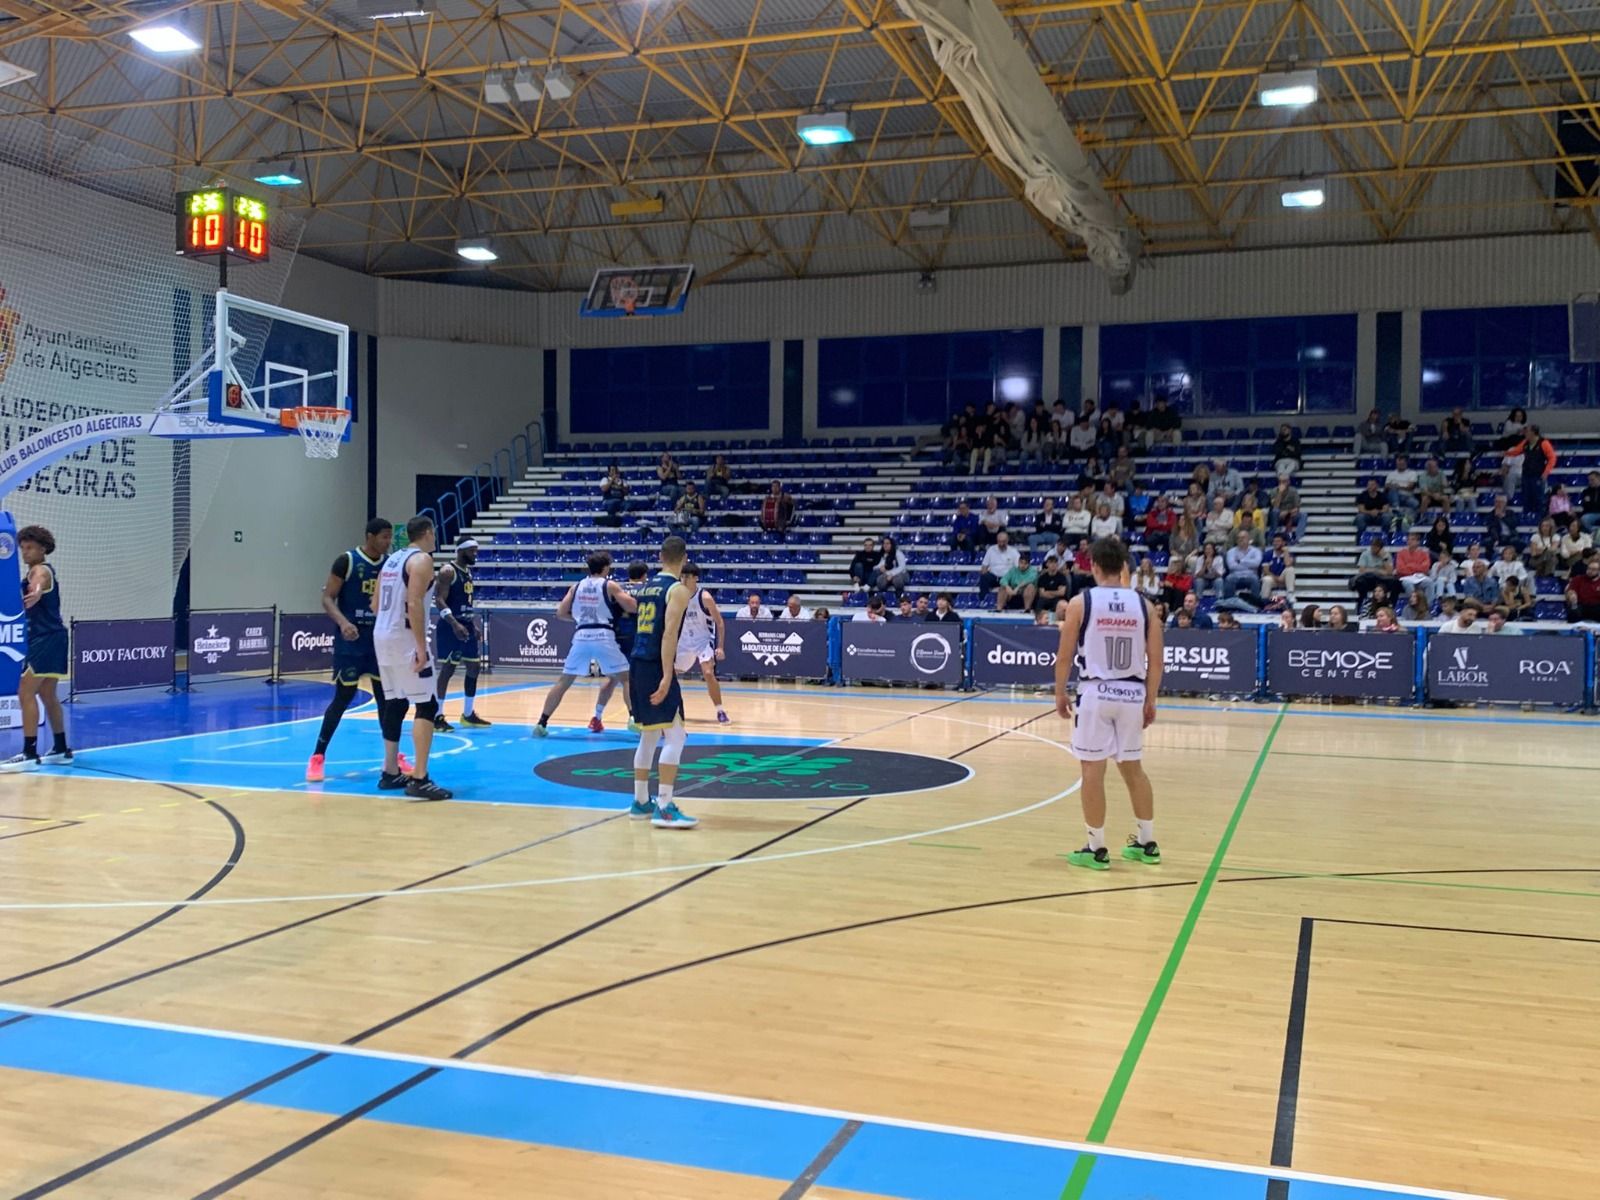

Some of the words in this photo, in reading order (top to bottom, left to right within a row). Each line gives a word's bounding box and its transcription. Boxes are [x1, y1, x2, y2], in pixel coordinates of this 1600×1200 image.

[192, 214, 220, 247] 10
[239, 219, 262, 254] 10
[23, 323, 137, 360] Ayuntamiento
[23, 350, 45, 368] de
[50, 350, 138, 384] Algeciras
[0, 454, 19, 477] LUB
[18, 424, 83, 461] BALONCESTO
[86, 415, 142, 434] ALGECIRAS
[101, 438, 136, 467] DE
[1108, 602, 1125, 613] KIKE
[637, 601, 656, 634] 22
[1096, 618, 1138, 628] MIRAMAR
[0, 623, 25, 644] ME
[297, 633, 336, 651] popular
[81, 649, 116, 663] BODY
[117, 645, 168, 661] FACTORY
[748, 644, 772, 652] BOUTIQUE
[785, 645, 802, 653] CARNE
[1104, 636, 1133, 670] 10
[1163, 646, 1230, 664] ERSUR
[1301, 669, 1377, 679] CENTER
[1438, 671, 1488, 682] LABOR
[1519, 660, 1571, 675] ROA
